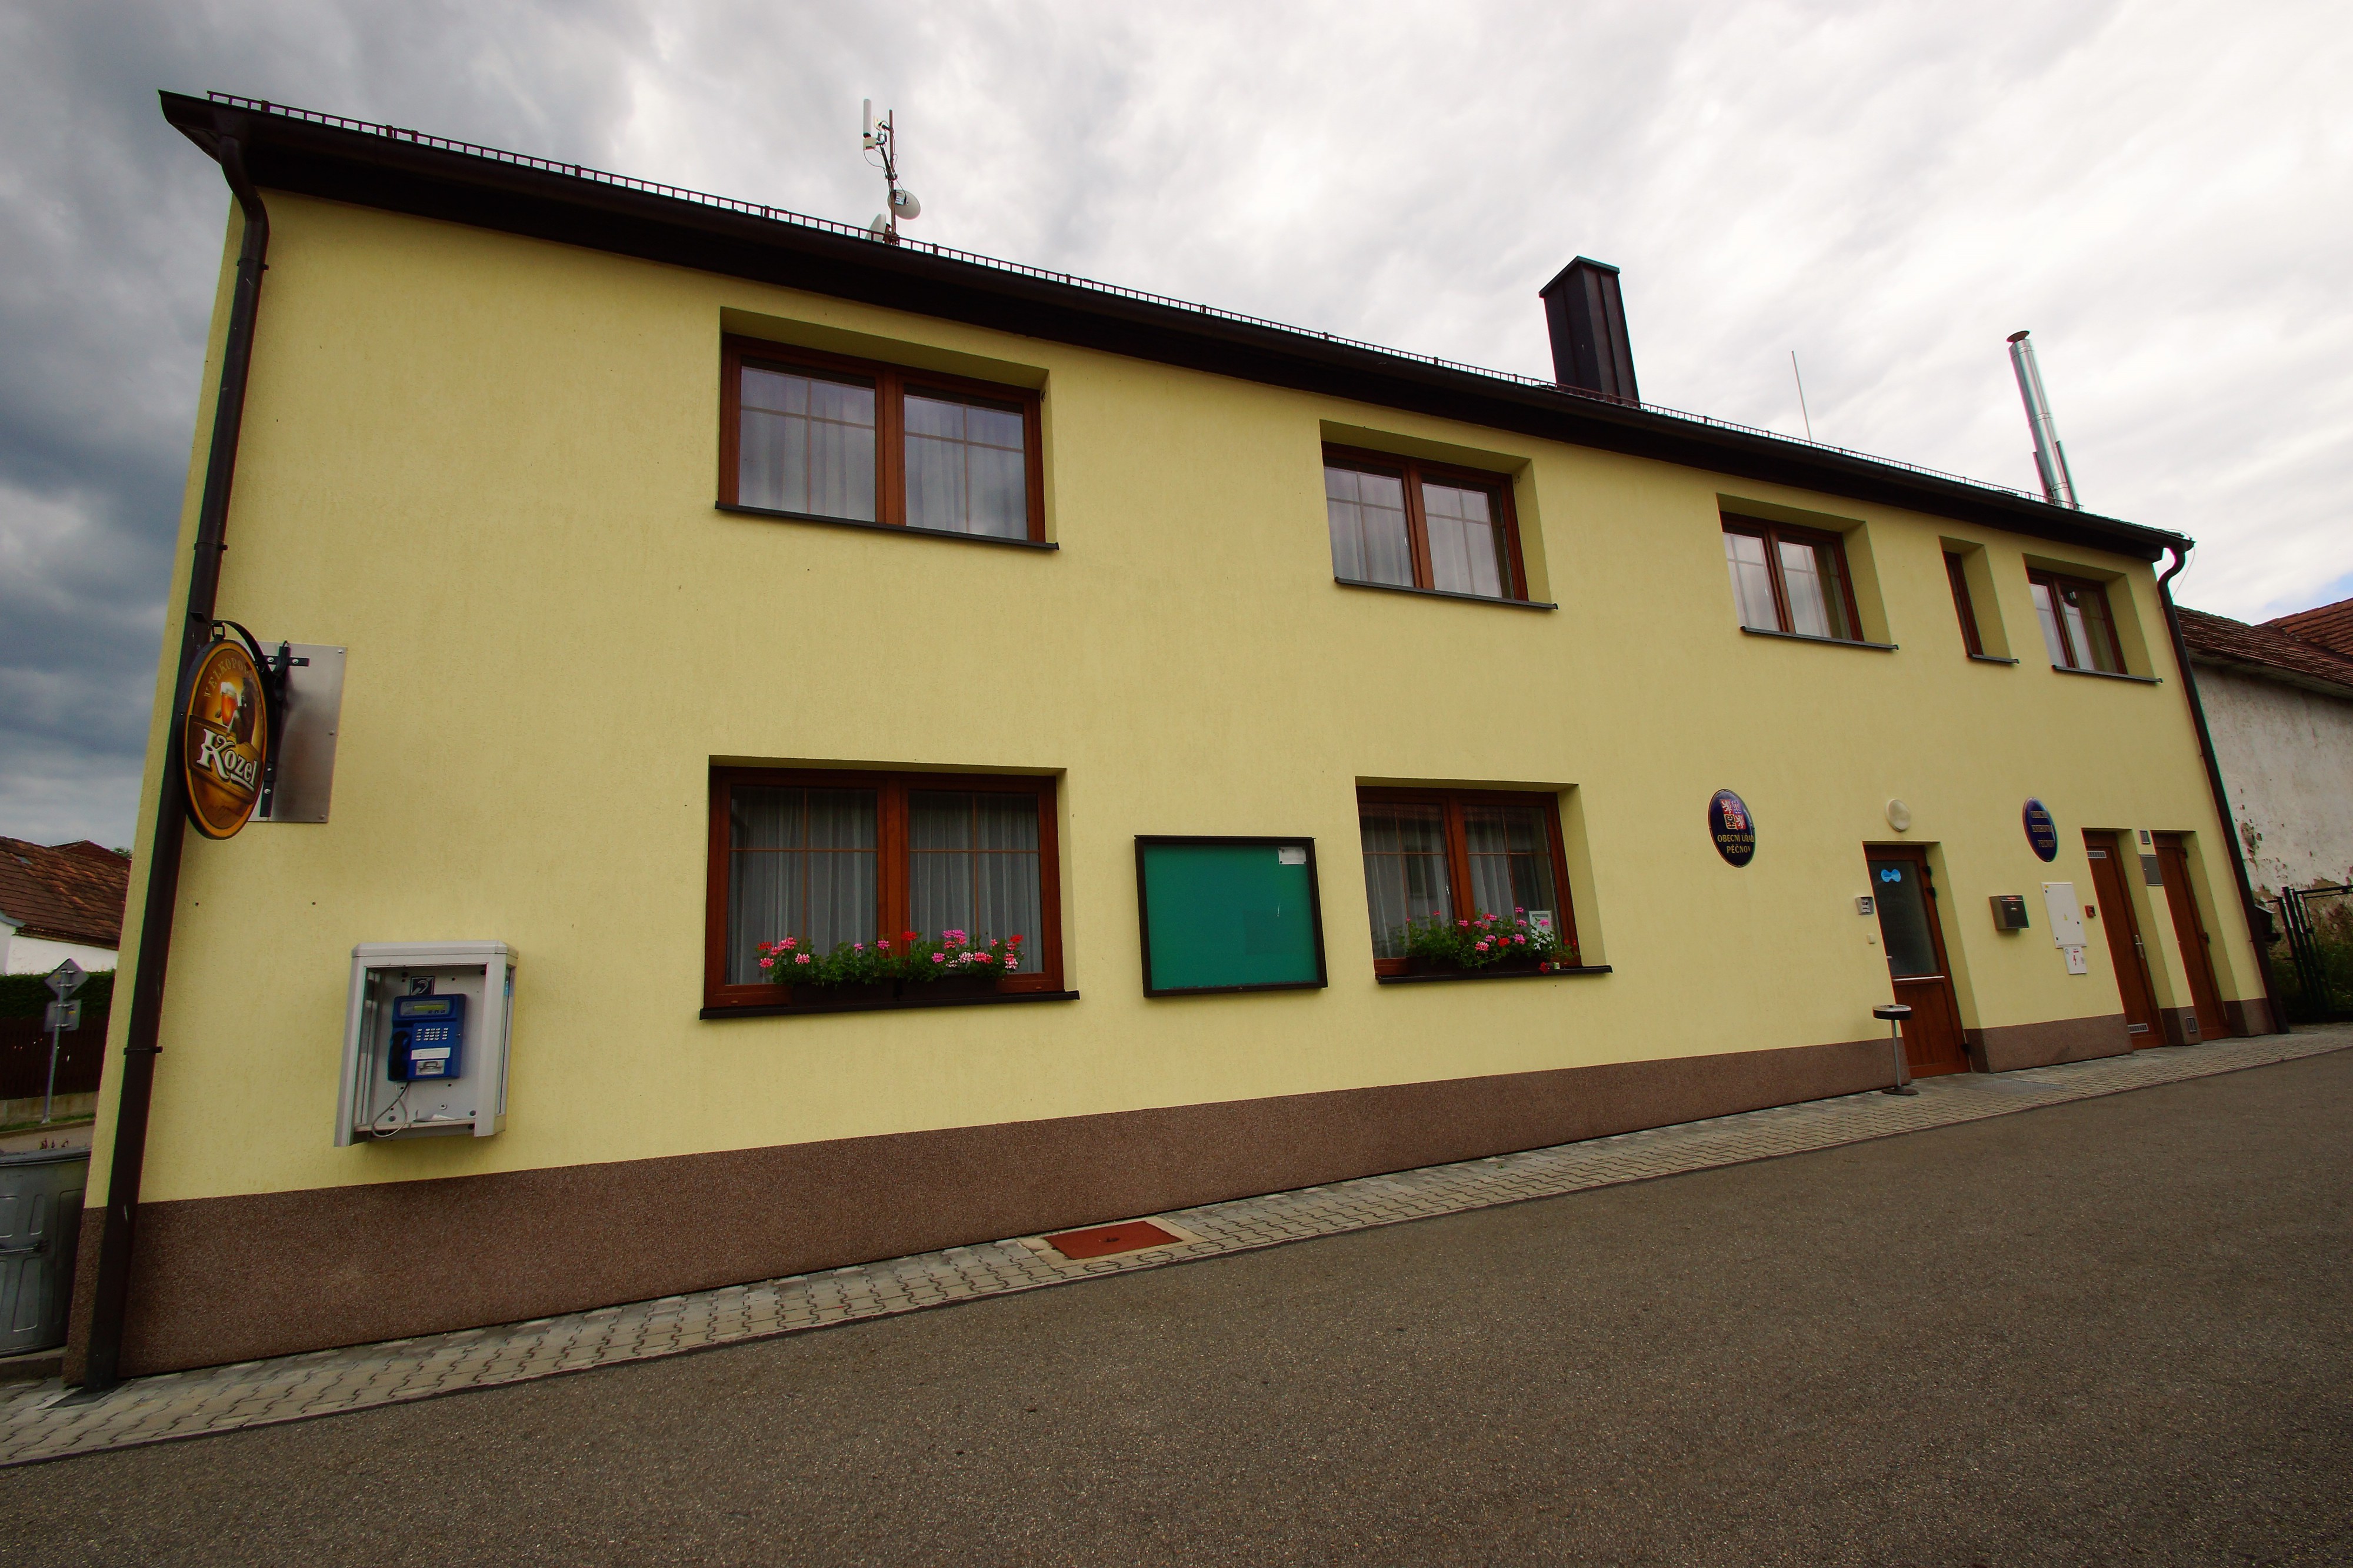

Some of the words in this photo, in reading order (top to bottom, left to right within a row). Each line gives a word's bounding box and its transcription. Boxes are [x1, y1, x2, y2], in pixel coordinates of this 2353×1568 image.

[197, 729, 257, 786] Kozel
[1717, 833, 1741, 842] OBECNÍ
[1726, 844, 1751, 853] PĚČNOV
